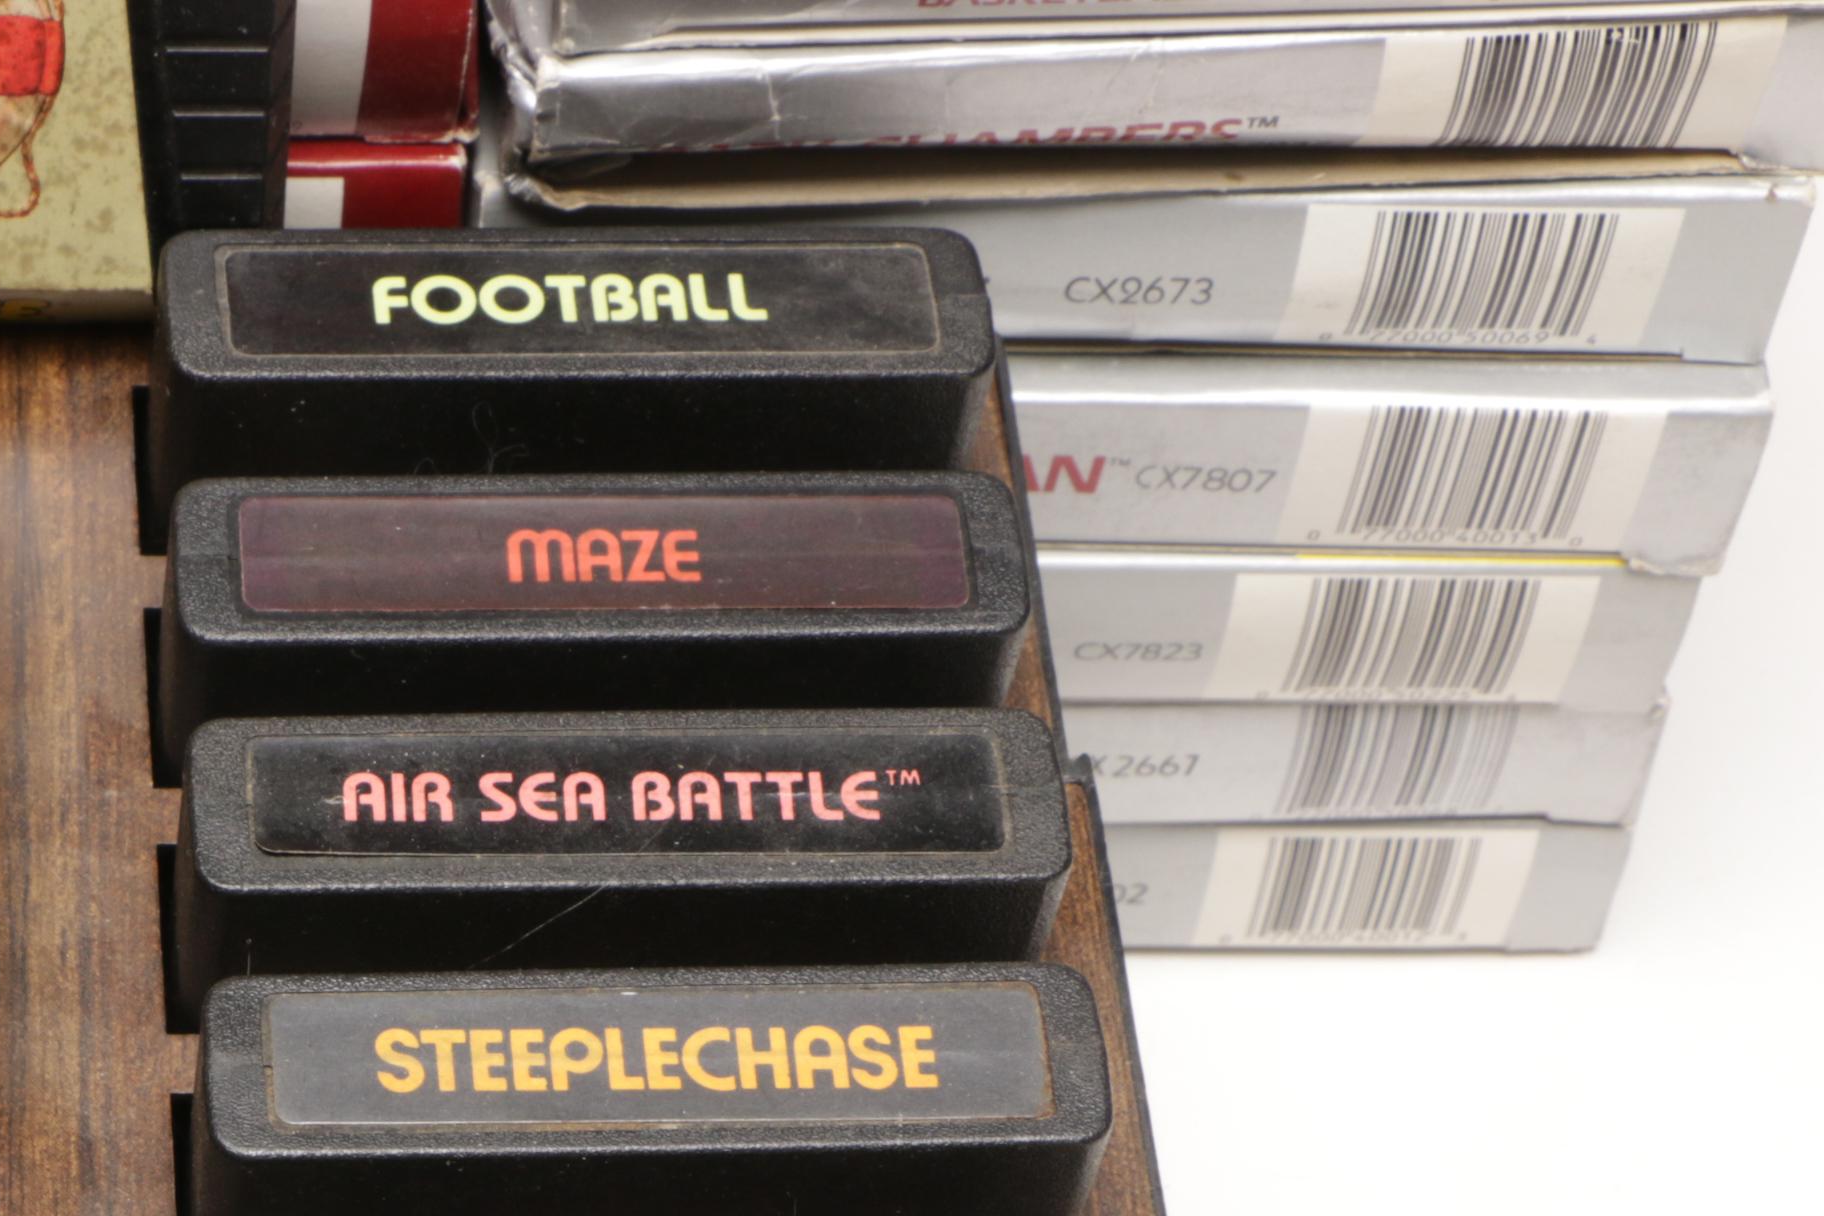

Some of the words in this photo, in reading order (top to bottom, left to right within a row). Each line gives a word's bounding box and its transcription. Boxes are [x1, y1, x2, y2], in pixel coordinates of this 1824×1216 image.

[372, 273, 768, 325] FOOTBALL
[1064, 276, 1214, 306] CX2673
[1134, 464, 1277, 494] CX7807
[507, 529, 702, 583] MAZE
[1073, 642, 1204, 662] CX7823
[343, 769, 454, 823] AIR
[479, 770, 606, 822] SEA
[374, 1024, 940, 1094] STEEPLECHASE
